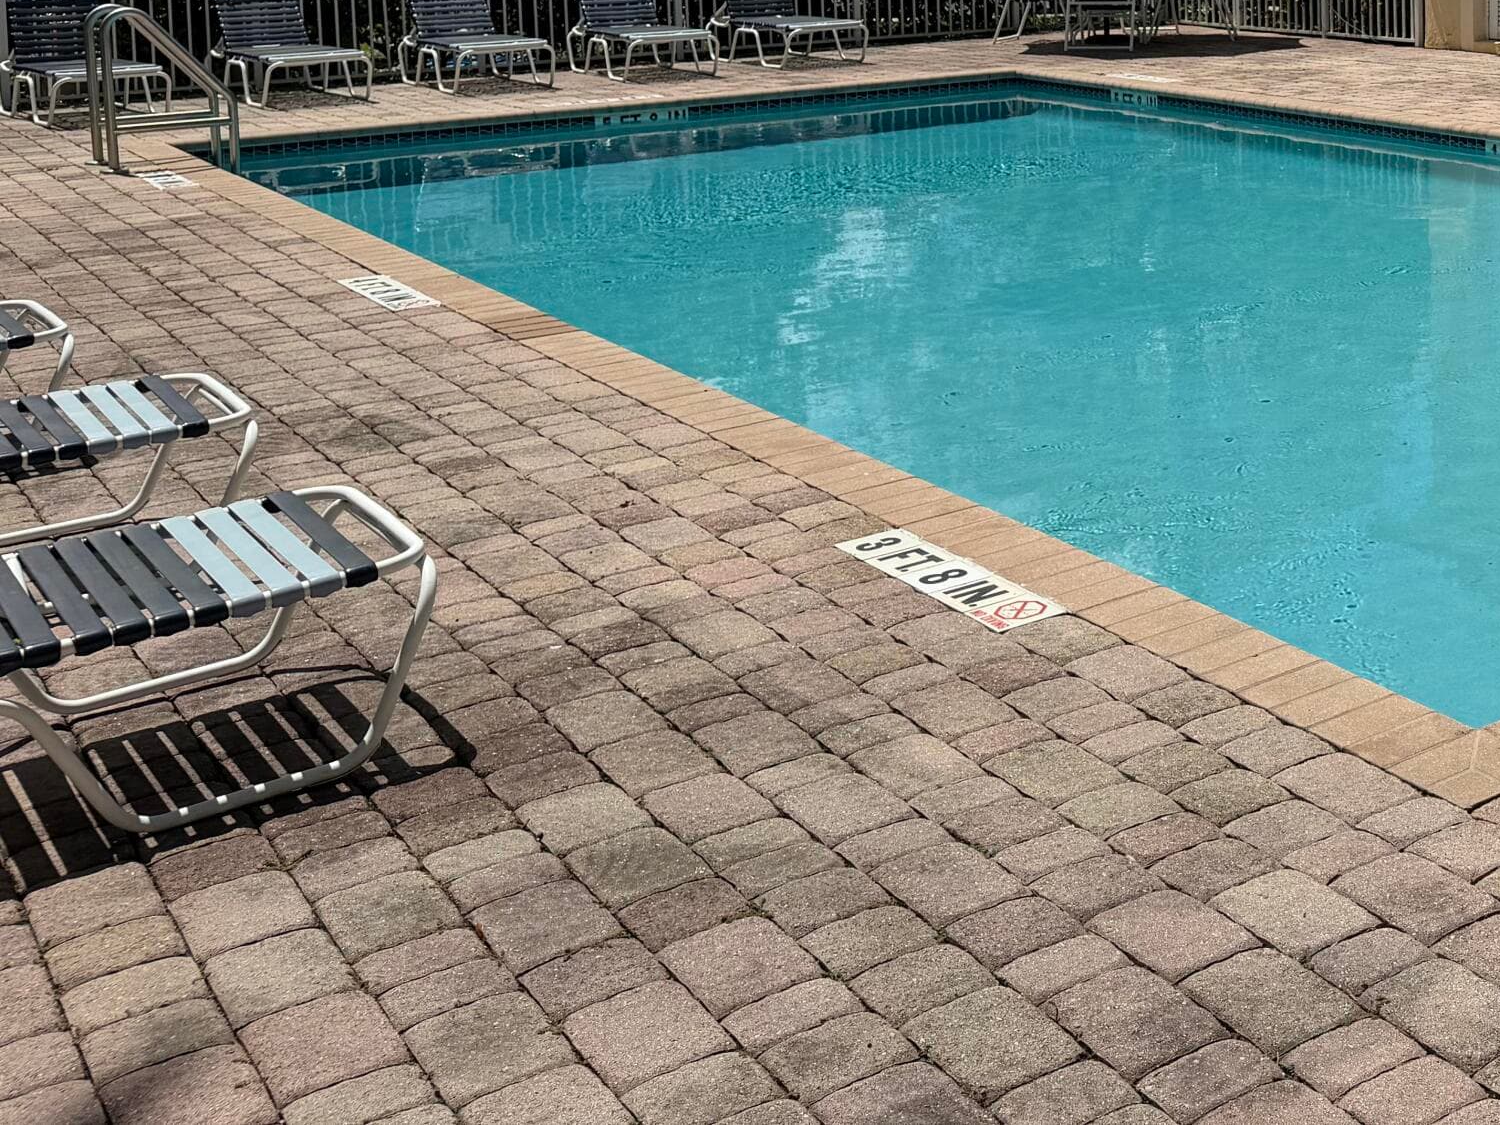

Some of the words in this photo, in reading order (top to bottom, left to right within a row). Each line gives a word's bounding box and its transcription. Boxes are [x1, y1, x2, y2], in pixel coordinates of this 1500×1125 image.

[855, 537, 902, 552] 3
[877, 547, 945, 573] FT.
[919, 568, 968, 585] 8
[943, 580, 1010, 607] IN.
